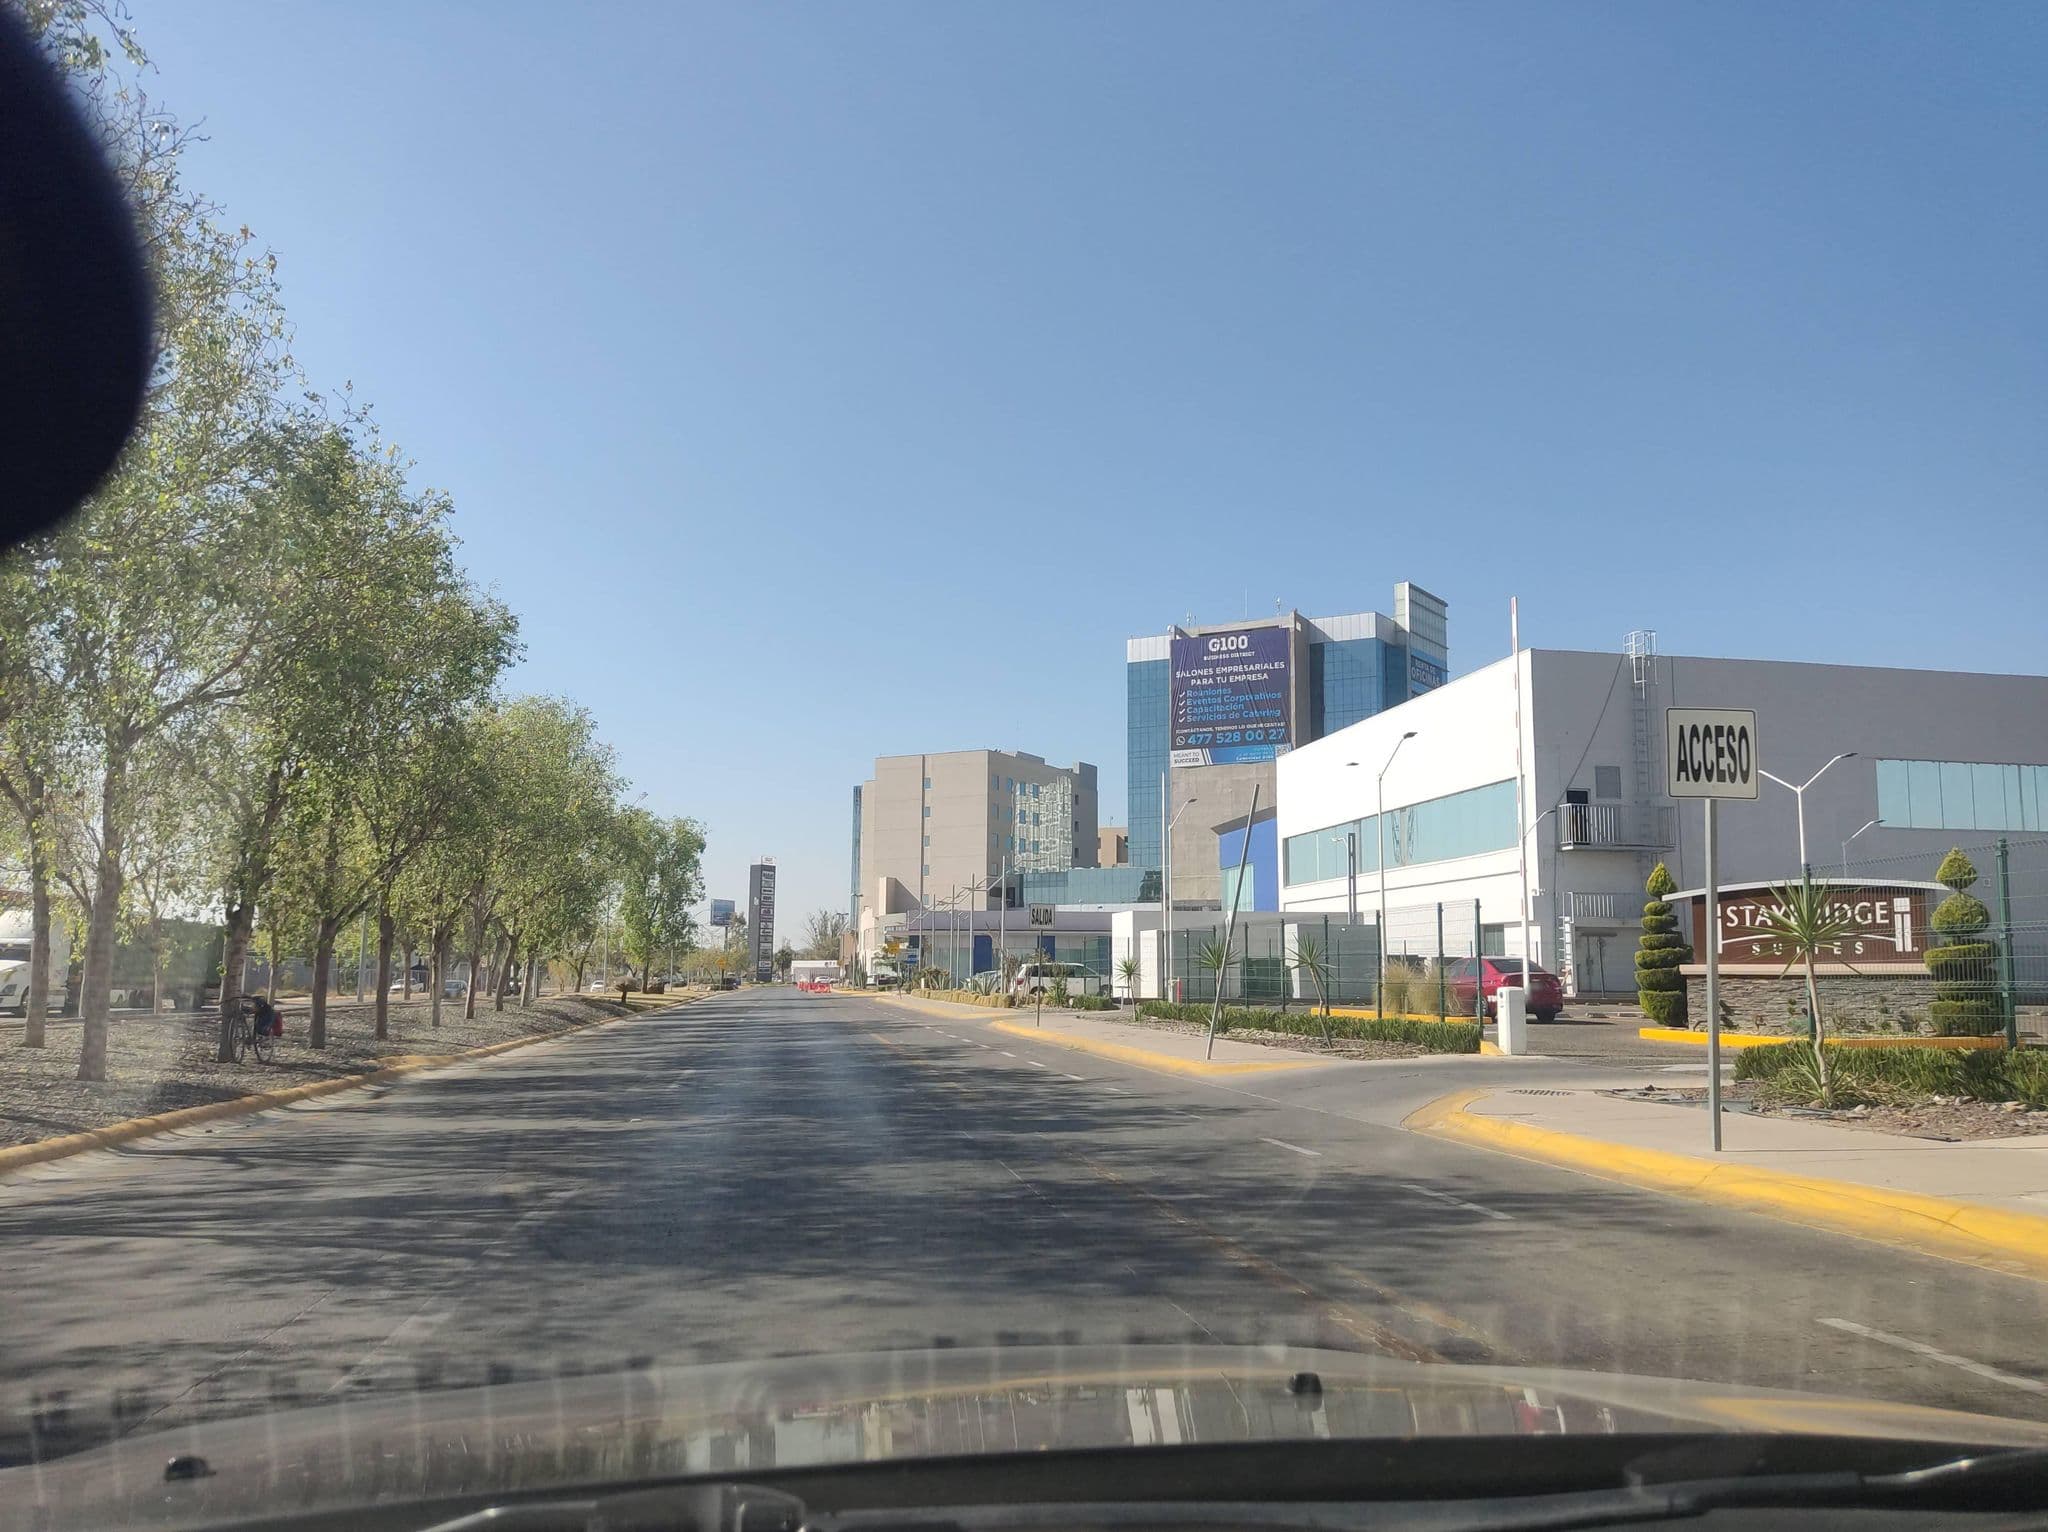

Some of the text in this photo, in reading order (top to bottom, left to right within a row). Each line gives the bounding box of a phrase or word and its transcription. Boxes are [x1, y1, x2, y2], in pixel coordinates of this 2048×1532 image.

[1208, 635, 1249, 652] G100
[1175, 661, 1285, 678] SALONES EMPRESARIALES
[1191, 673, 1269, 686] PARA TU EMPRESA
[1186, 687, 1232, 698] Reuniones
[1186, 692, 1282, 706] Eventos Corporativos
[1186, 702, 1245, 715] Capacitación
[1186, 708, 1281, 723] Servicios de Catering
[1187, 733, 1213, 745] 477
[1215, 731, 1241, 744] 528
[1244, 729, 1264, 742] 00
[1676, 724, 1750, 784] ACCESO
[1031, 908, 1053, 926] SALIDA
[1726, 901, 1889, 927] STAYIDGE
